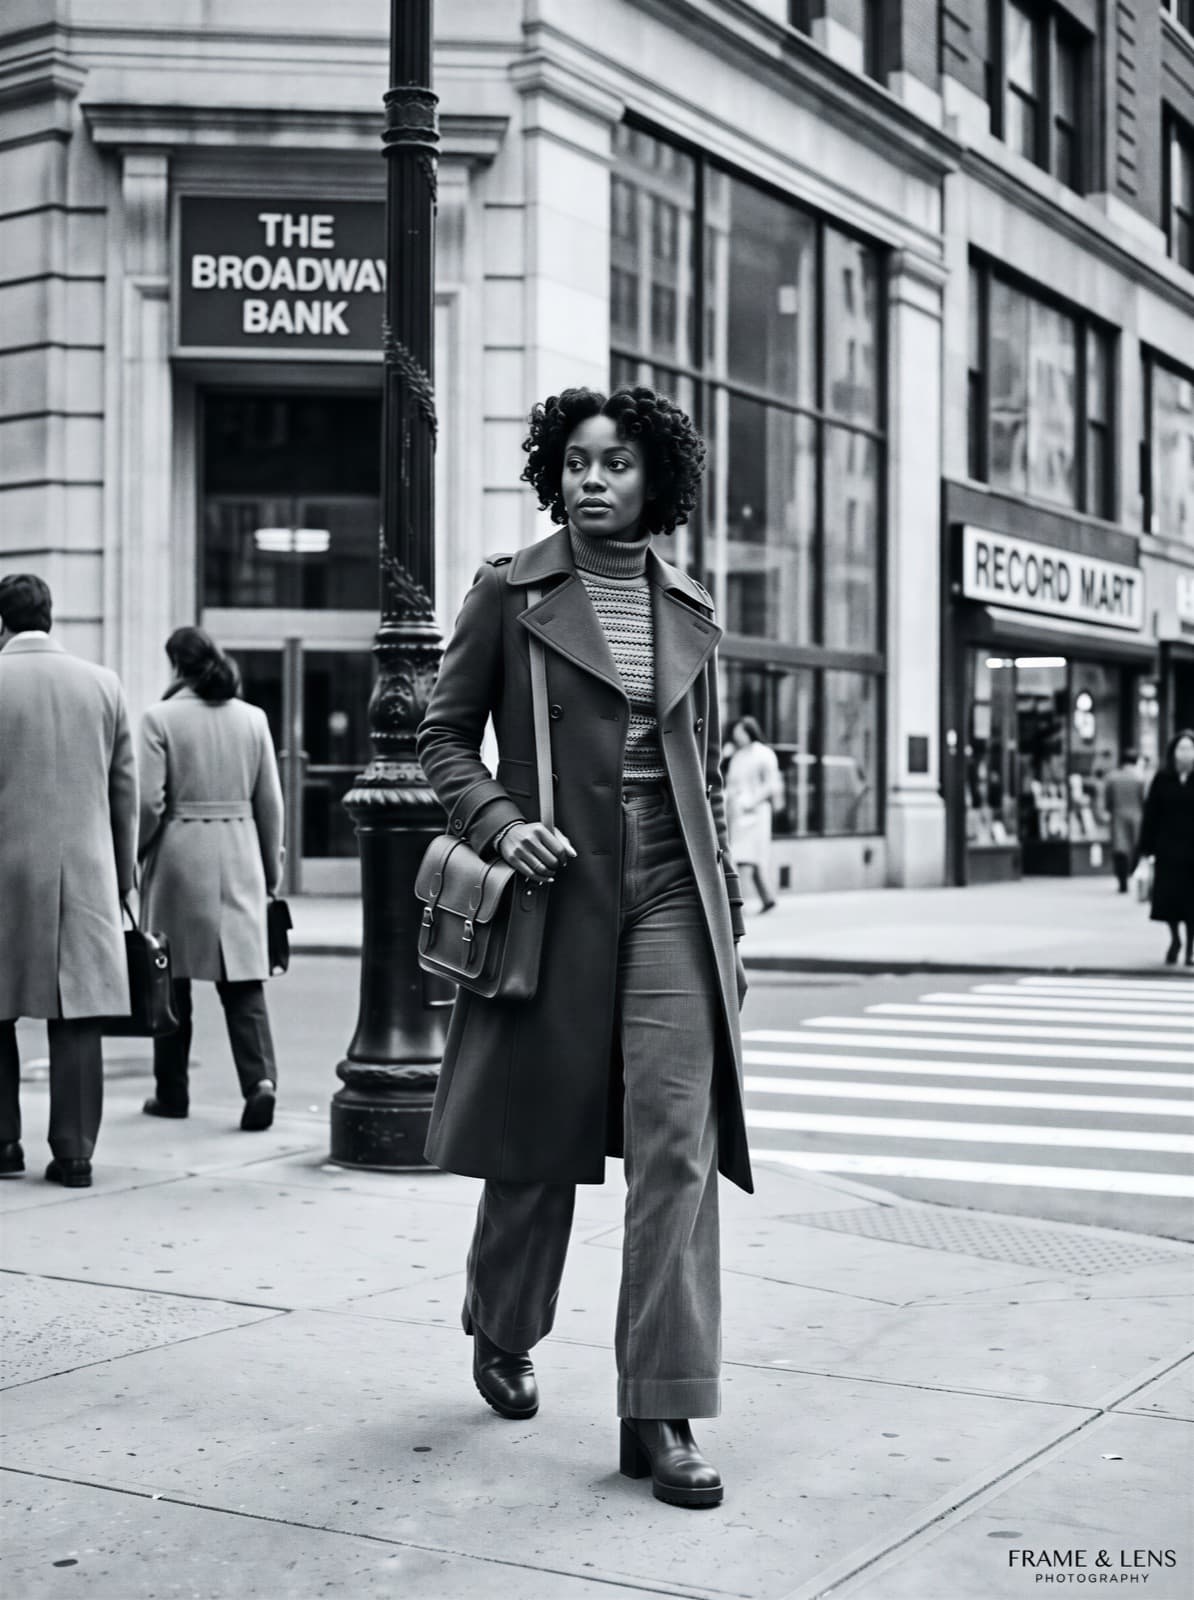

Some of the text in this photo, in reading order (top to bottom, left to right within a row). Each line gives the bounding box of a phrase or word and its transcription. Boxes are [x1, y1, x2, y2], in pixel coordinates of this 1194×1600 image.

[258, 213, 335, 249] THE
[243, 299, 349, 335] BANK
[975, 541, 1070, 603] RECORD
[1080, 566, 1135, 617] MART
